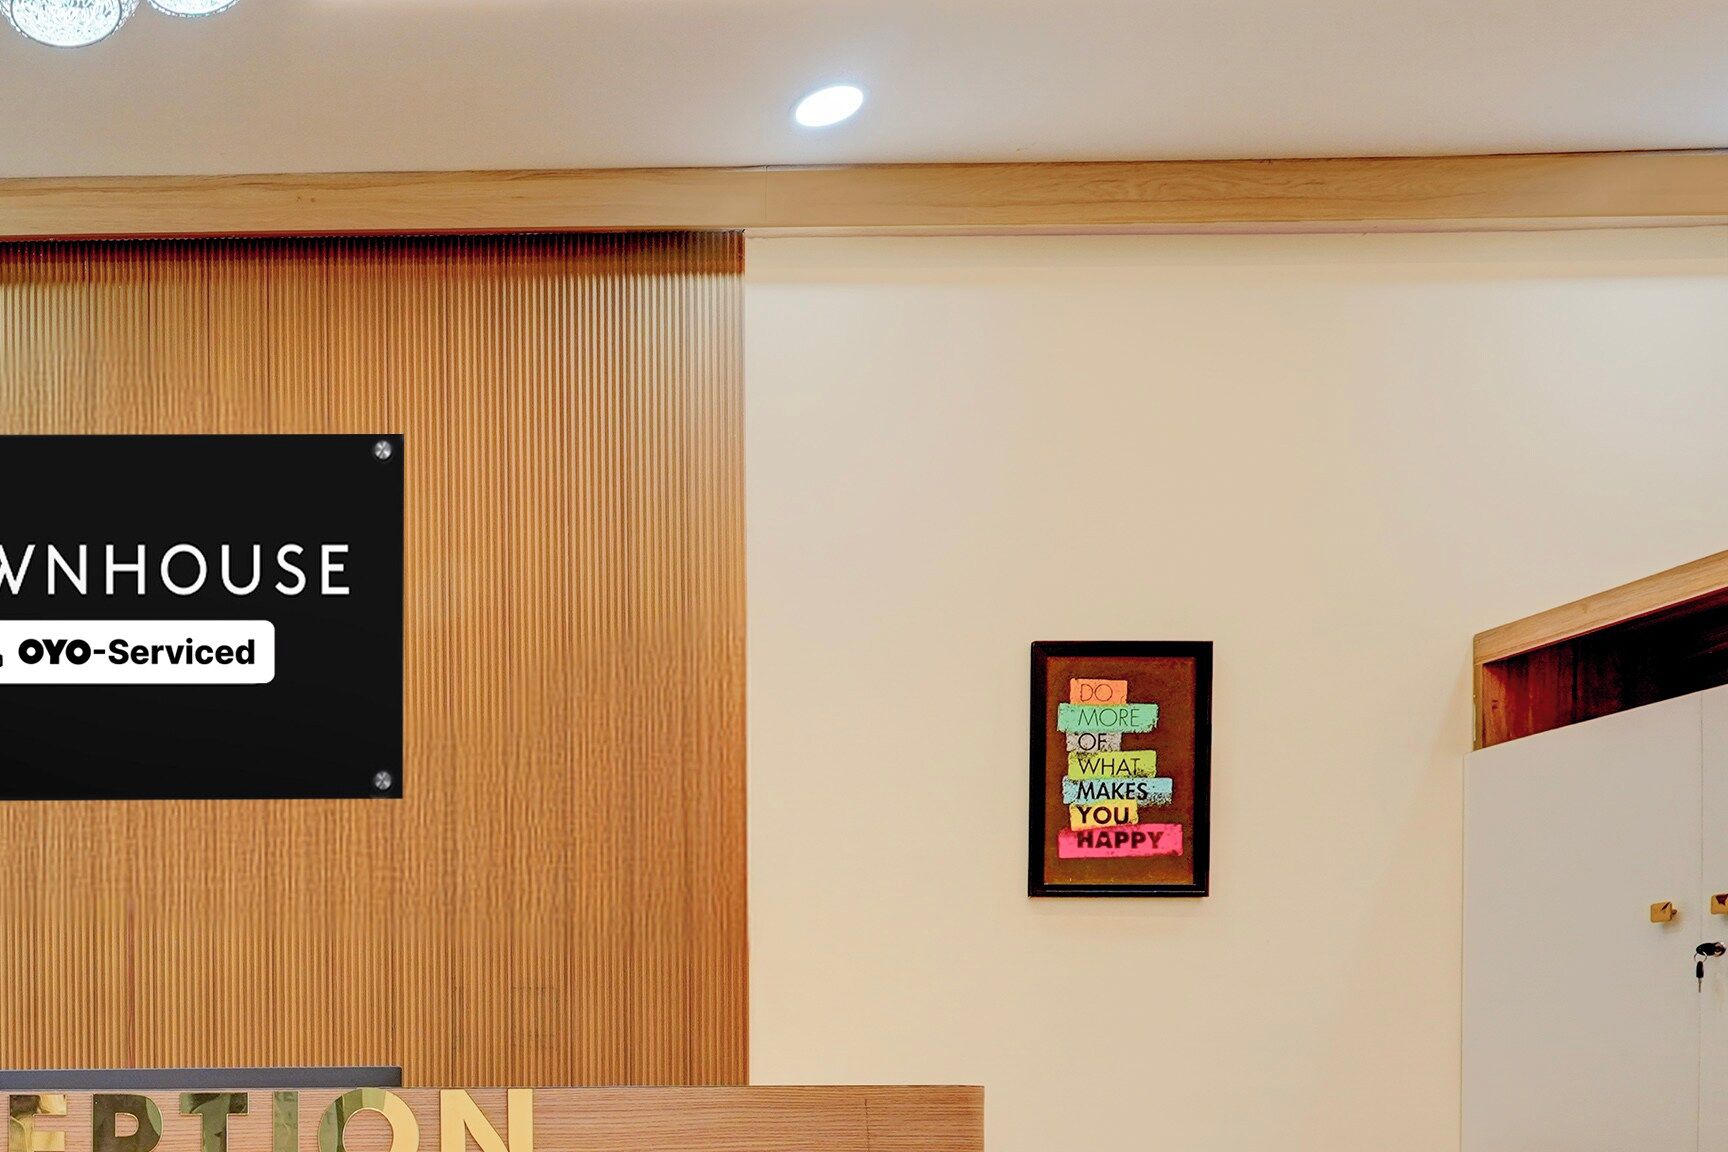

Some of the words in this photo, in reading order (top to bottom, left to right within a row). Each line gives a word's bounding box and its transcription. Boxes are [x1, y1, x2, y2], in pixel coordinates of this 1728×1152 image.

[18, 637, 256, 666] OYO-Serviced
[1080, 683, 1113, 702] DO
[1077, 708, 1140, 727] MORE
[1078, 732, 1107, 751] OF
[1078, 758, 1140, 776] WHAT
[1077, 782, 1148, 800] MAKES
[1077, 806, 1129, 825] YOU
[1077, 831, 1164, 849] HAPPY
